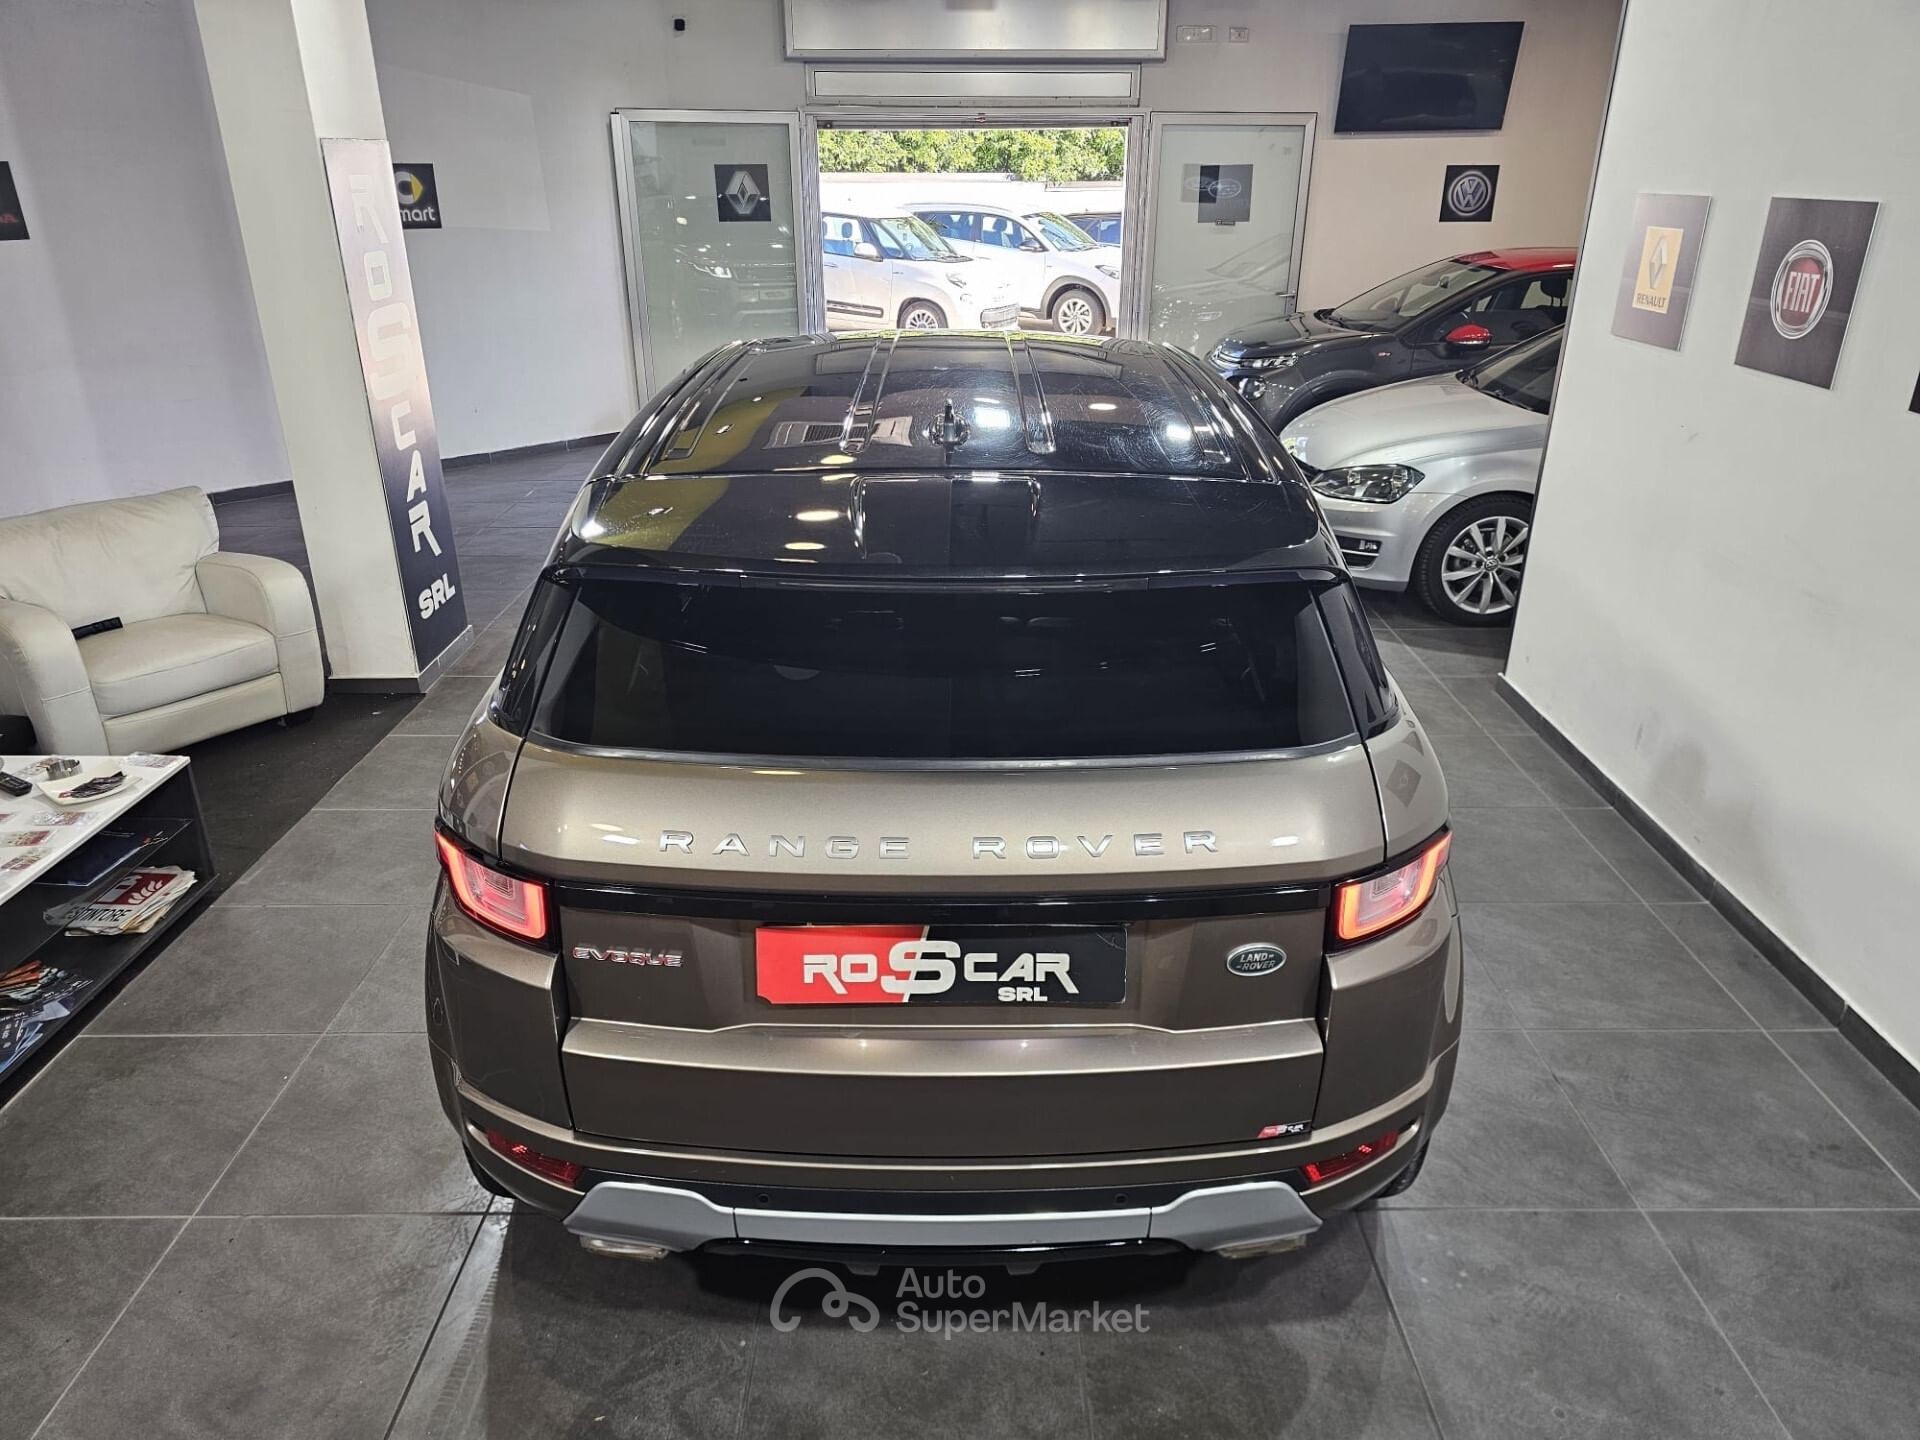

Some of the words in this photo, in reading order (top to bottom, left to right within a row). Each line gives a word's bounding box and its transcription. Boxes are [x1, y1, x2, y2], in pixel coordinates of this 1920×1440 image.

[399, 206, 436, 222] mart
[1636, 292, 1668, 309] RENAULT
[1782, 271, 1821, 313] FIAT
[418, 573, 456, 619] SRL
[658, 829, 912, 860] RANGE
[972, 830, 1219, 860] ROVER
[572, 945, 683, 968] EVOQUE
[997, 986, 1048, 1002] SRL
